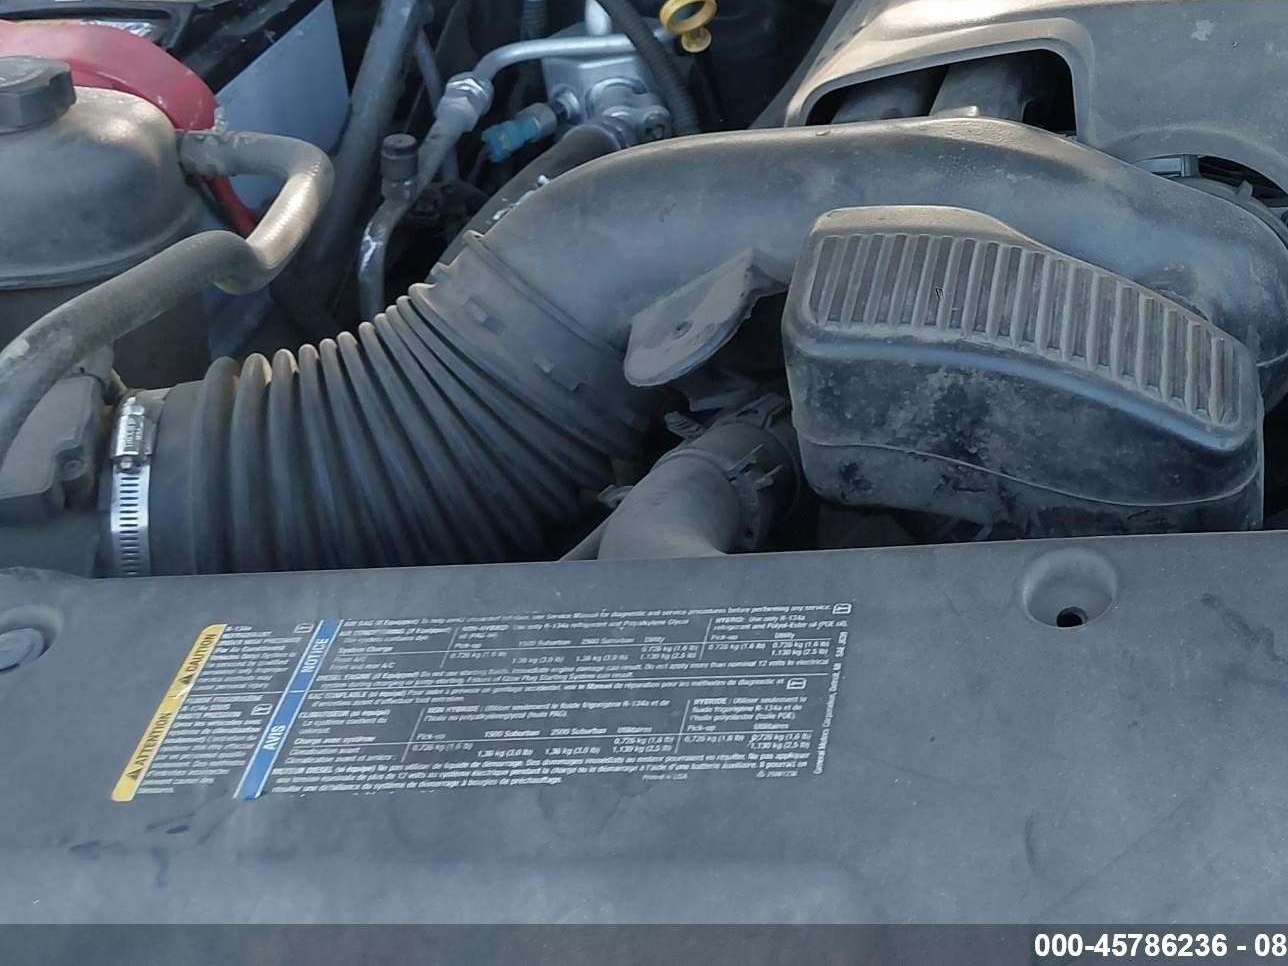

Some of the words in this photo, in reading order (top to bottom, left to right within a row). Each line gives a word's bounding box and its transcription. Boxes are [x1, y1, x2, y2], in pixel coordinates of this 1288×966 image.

[186, 634, 217, 672] CAUTION
[301, 637, 330, 673] NOTICE
[135, 712, 173, 766] ATTENTION
[262, 724, 286, 751] AVIS
